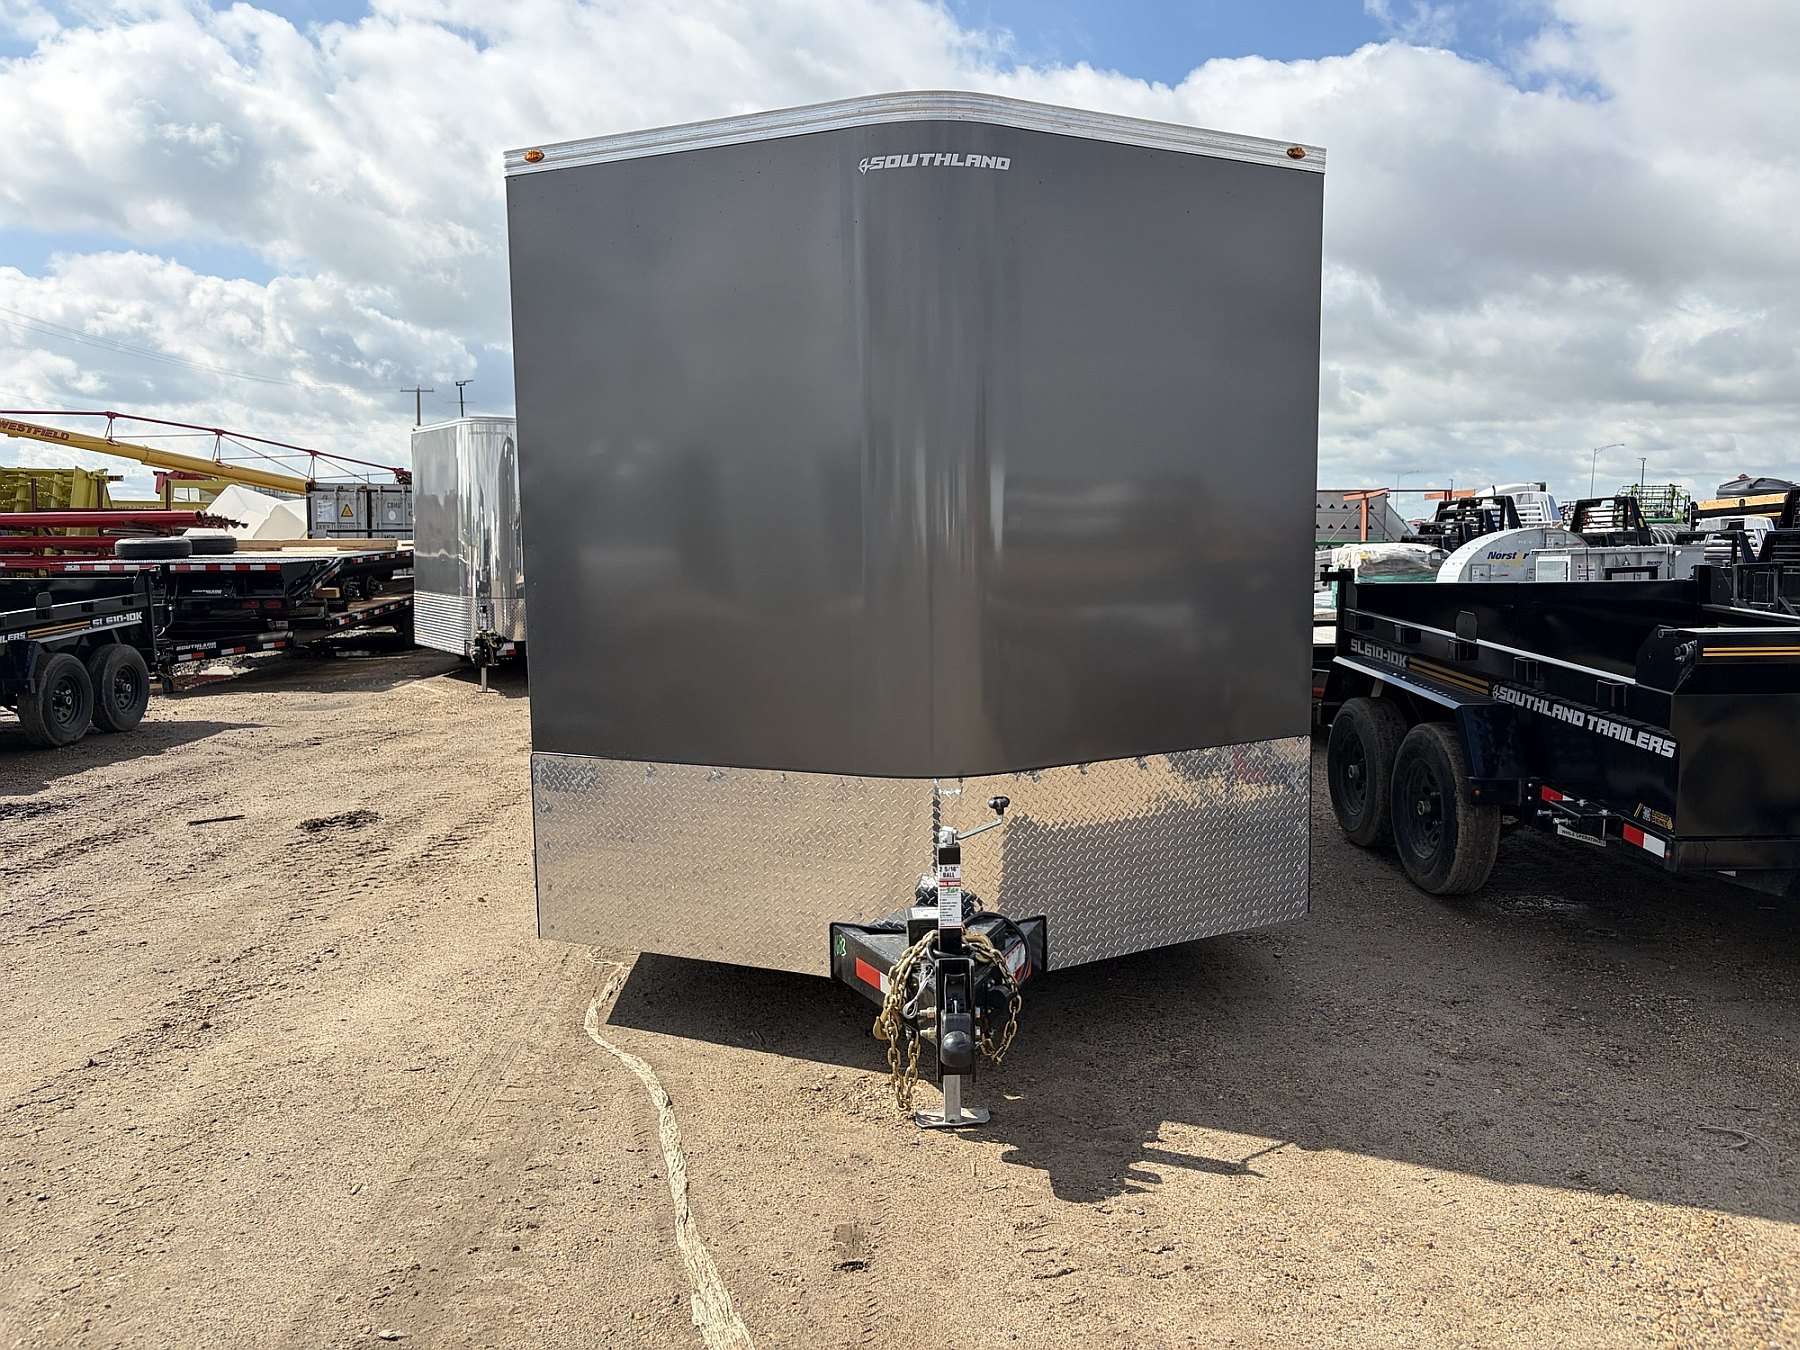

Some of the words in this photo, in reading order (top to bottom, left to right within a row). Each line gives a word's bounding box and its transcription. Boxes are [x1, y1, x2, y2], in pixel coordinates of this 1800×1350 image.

[869, 153, 1011, 171] SOUTHLAND
[1350, 638, 1408, 668] SL610-10K
[1499, 687, 1585, 727] SOUTHLAND
[1587, 714, 1676, 758] TRAILERS
